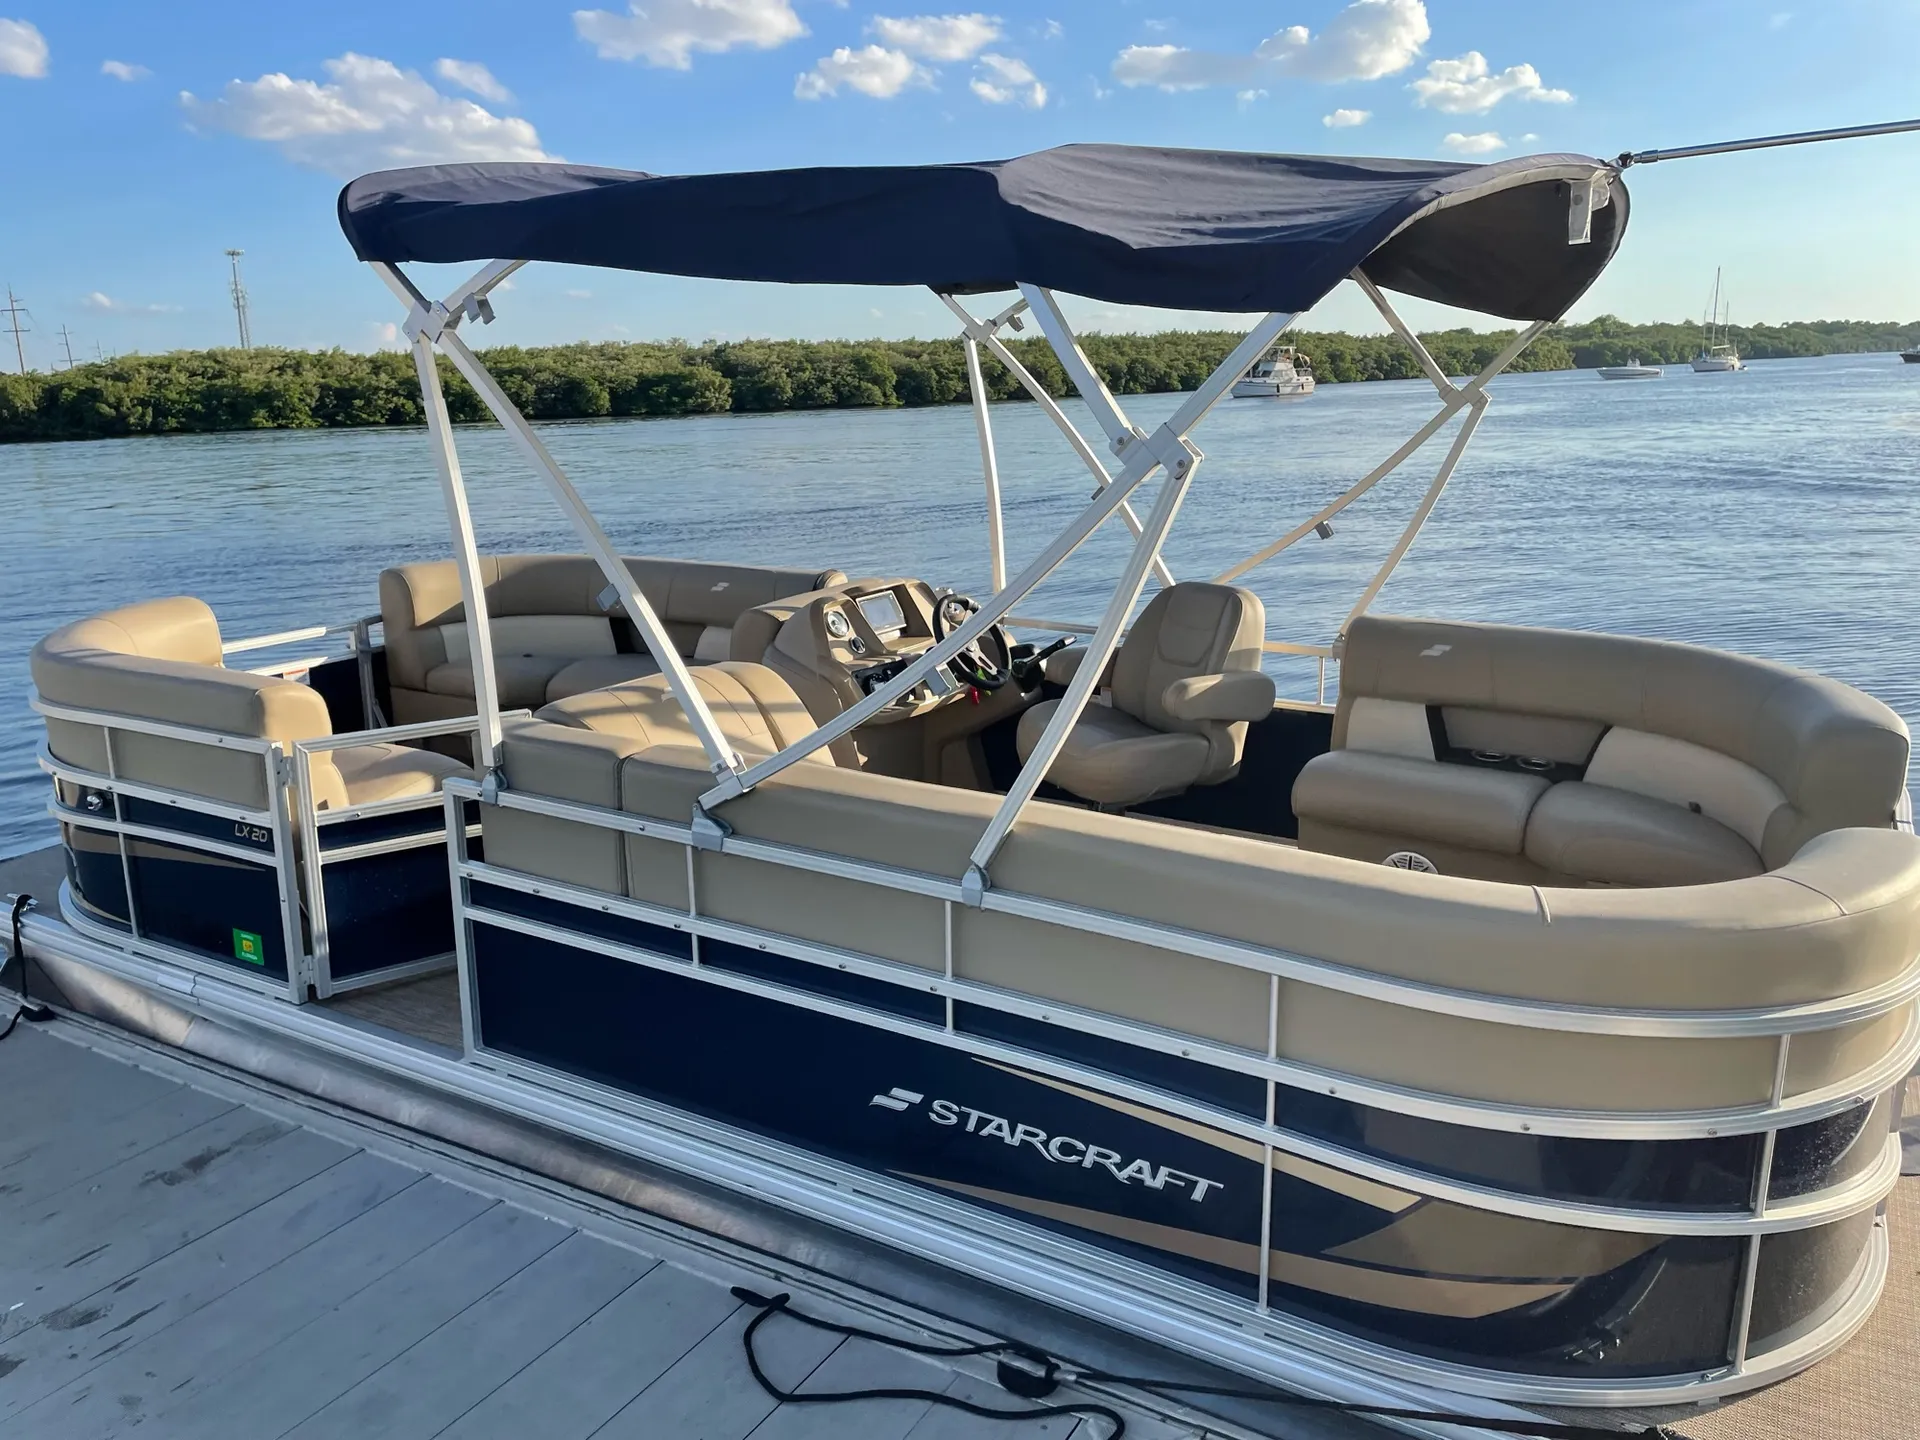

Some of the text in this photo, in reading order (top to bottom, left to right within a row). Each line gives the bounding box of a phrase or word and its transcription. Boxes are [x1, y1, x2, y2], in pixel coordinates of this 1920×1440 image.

[235, 823, 267, 842] LX 20
[928, 1099, 1224, 1203] STARCRAFT
